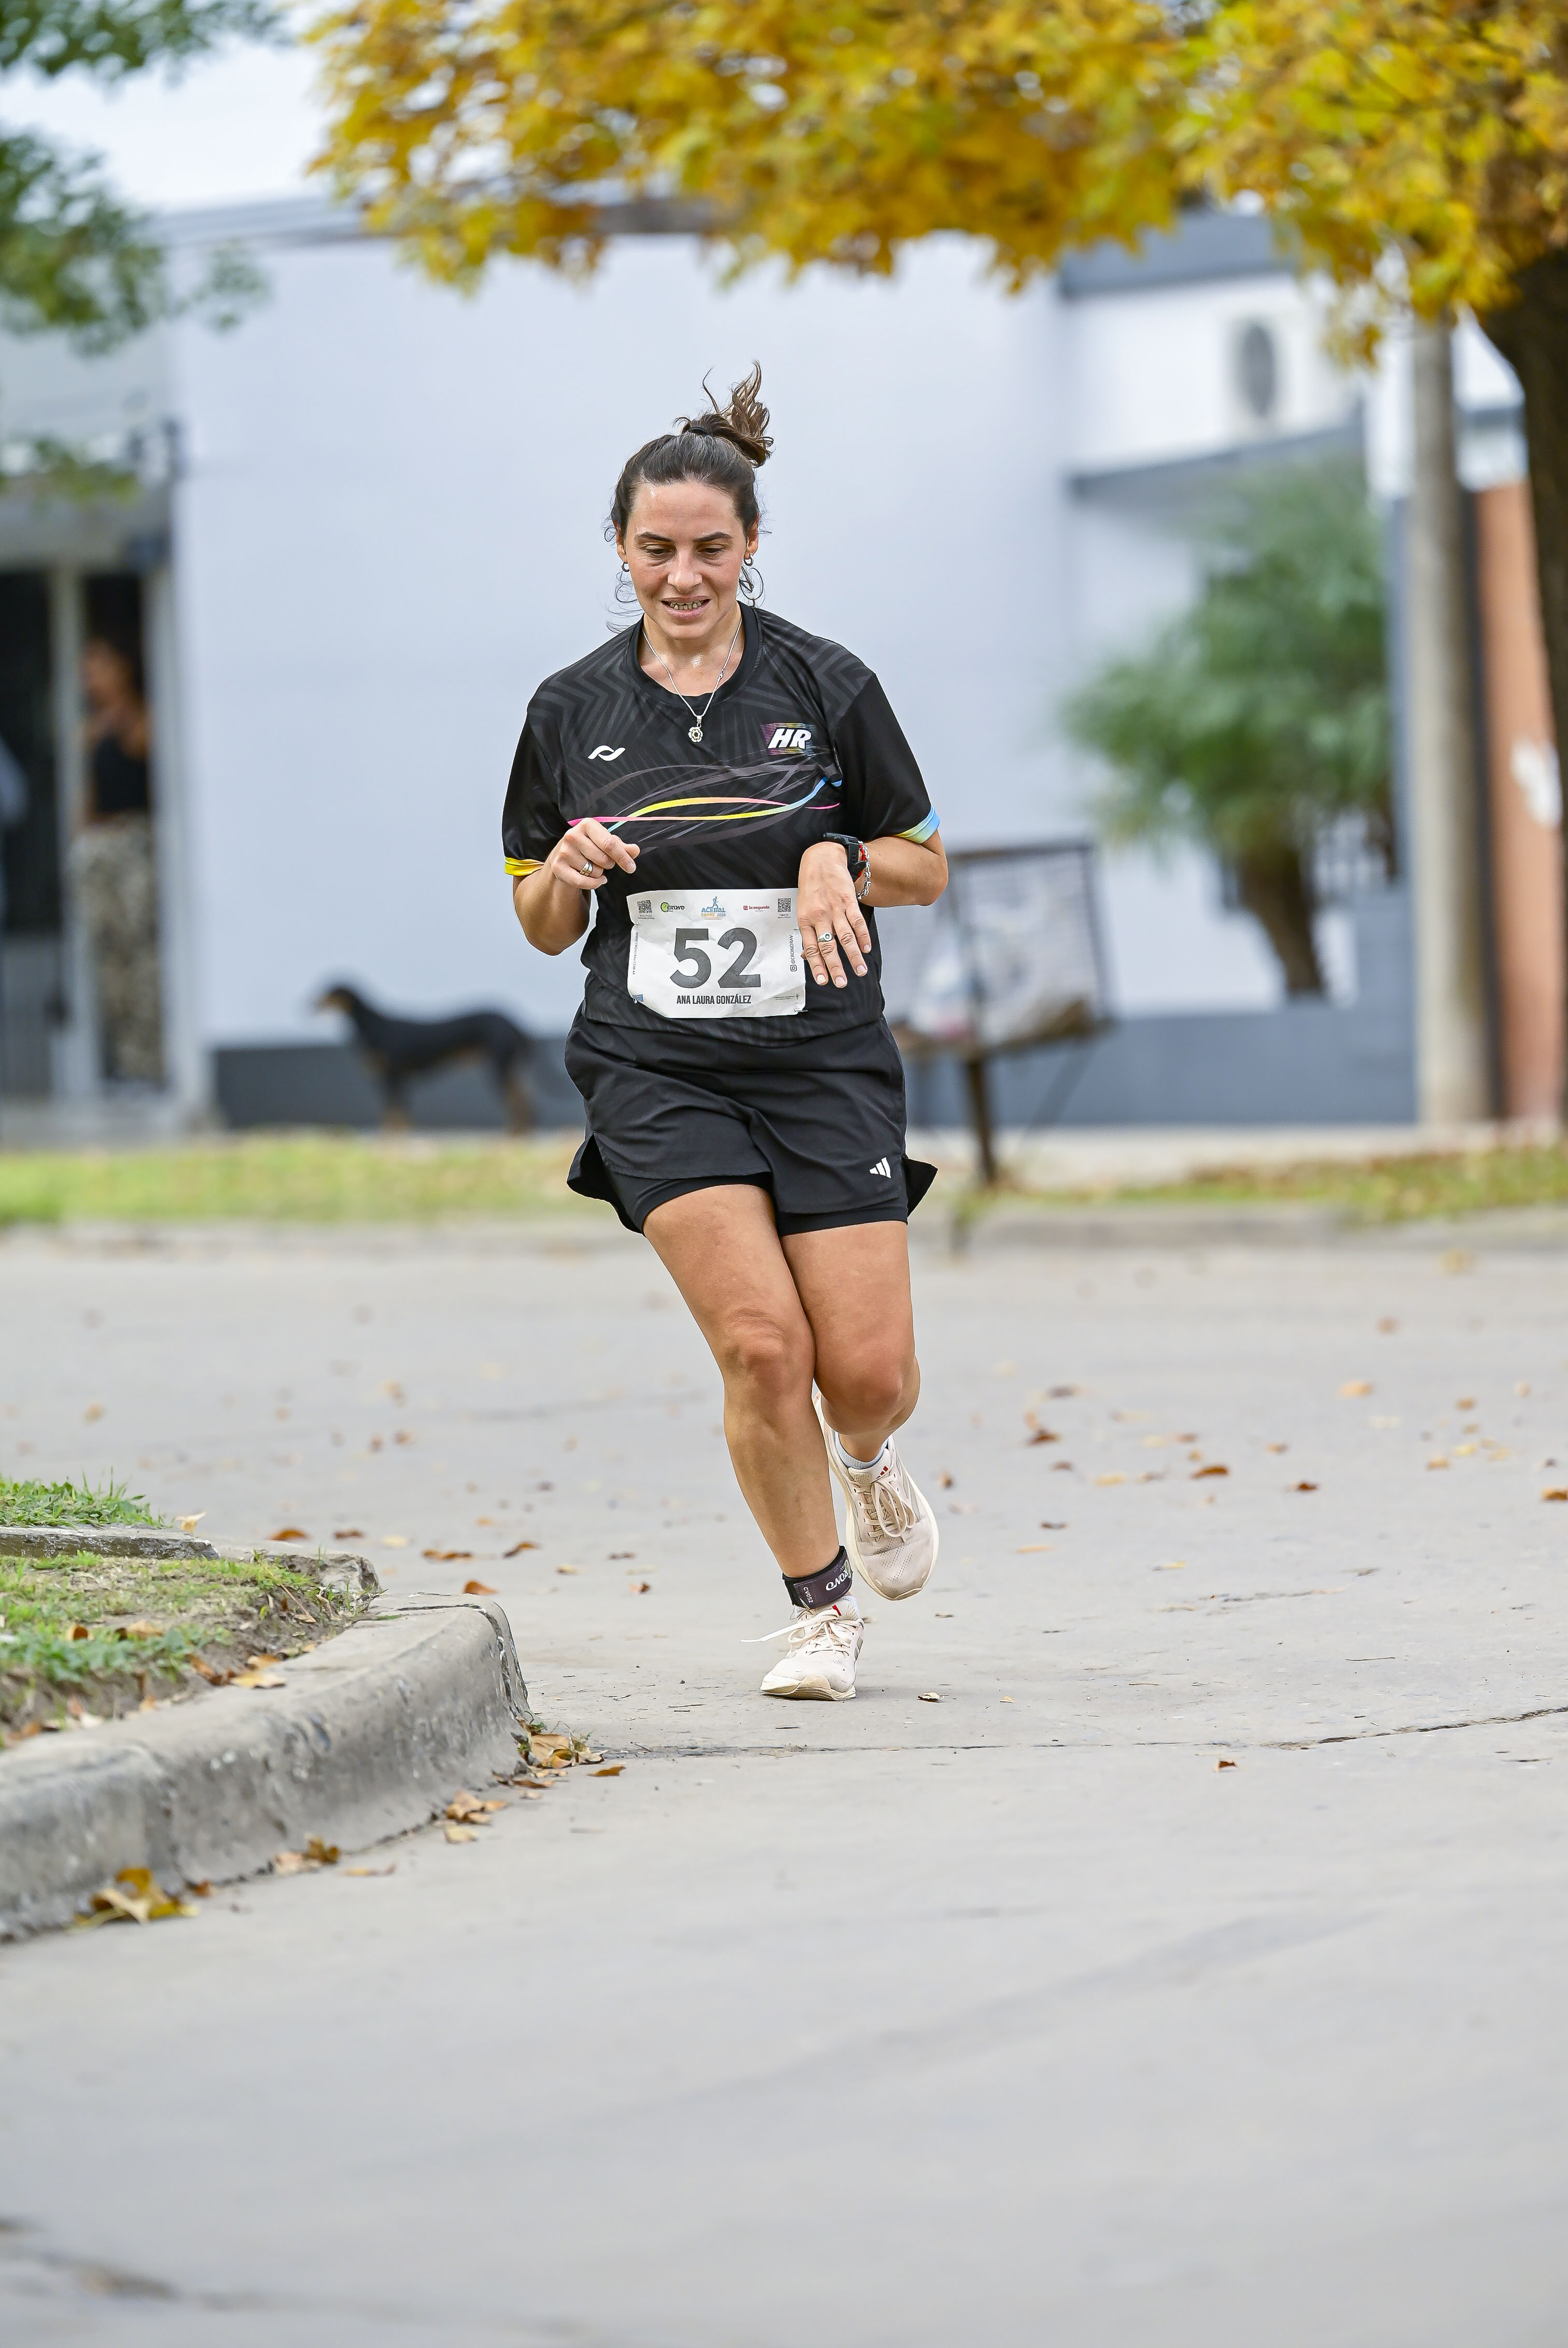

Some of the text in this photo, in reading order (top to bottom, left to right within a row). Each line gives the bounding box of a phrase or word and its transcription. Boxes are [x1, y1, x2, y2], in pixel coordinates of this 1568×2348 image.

[767, 728, 811, 749] HR
[670, 927, 761, 988] 52
[677, 994, 751, 1004] ANA LAURA GONZÁLEZ
[803, 1587, 814, 1603] CV052
